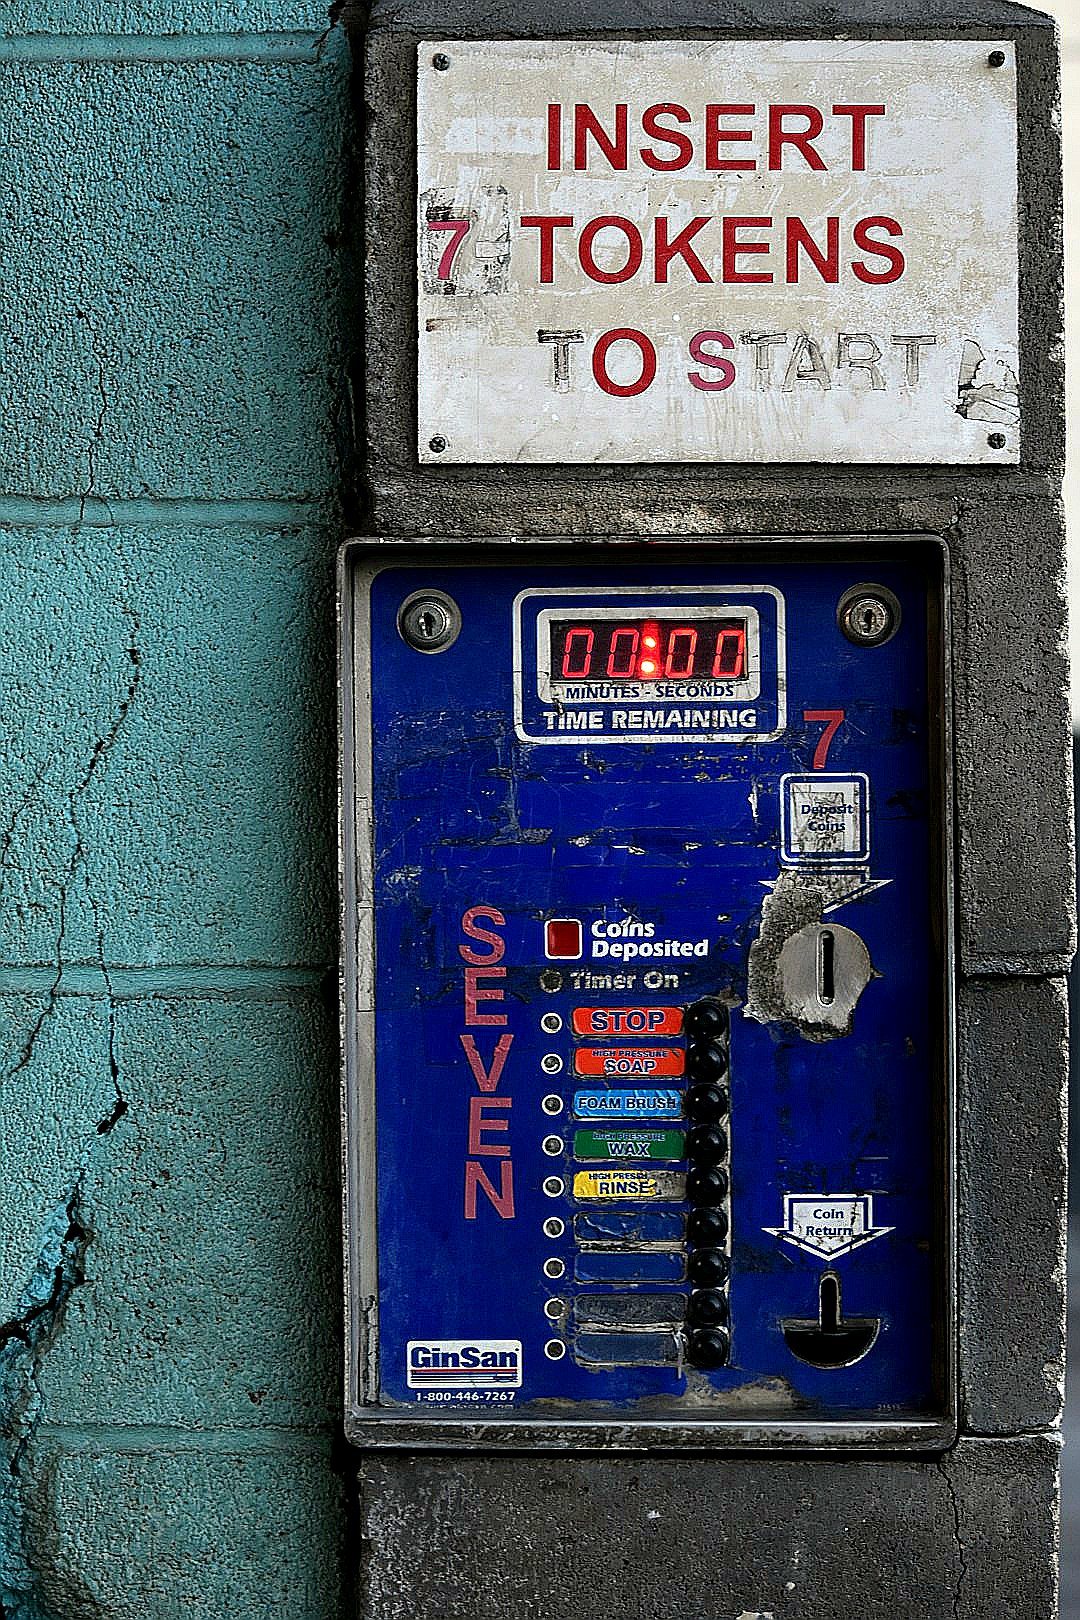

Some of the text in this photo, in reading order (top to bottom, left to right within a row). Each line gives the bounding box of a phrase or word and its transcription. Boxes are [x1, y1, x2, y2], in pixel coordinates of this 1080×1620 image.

[547, 103, 886, 171] INSERT
[428, 216, 905, 285] 7 TOKENS
[537, 328, 937, 397] TO START
[562, 628, 744, 678] 00:00
[565, 686, 640, 699] MINUTES
[655, 685, 734, 698] SECONDS
[543, 709, 757, 730] TIME REMAINING
[803, 710, 845, 769] 7
[801, 804, 855, 819] Deposit
[808, 820, 846, 832] Coins
[591, 916, 655, 938] Coins
[591, 939, 709, 961] Deposited
[570, 970, 679, 990] Timer On
[591, 1010, 665, 1031] STOP
[592, 1049, 669, 1058] HIGH PRESSURE
[604, 1058, 657, 1075] SOAP
[578, 1097, 678, 1110] FOAM BRUSH
[617, 1133, 665, 1142] PRESSURE
[607, 1141, 651, 1157] WAX
[589, 1173, 611, 1181] HIGH
[599, 1181, 651, 1195] RINSE
[813, 1208, 845, 1220] Coin
[806, 1225, 853, 1237] Return
[411, 1347, 518, 1368] GinSan
[416, 1391, 516, 1402] 1-800-446-7267
